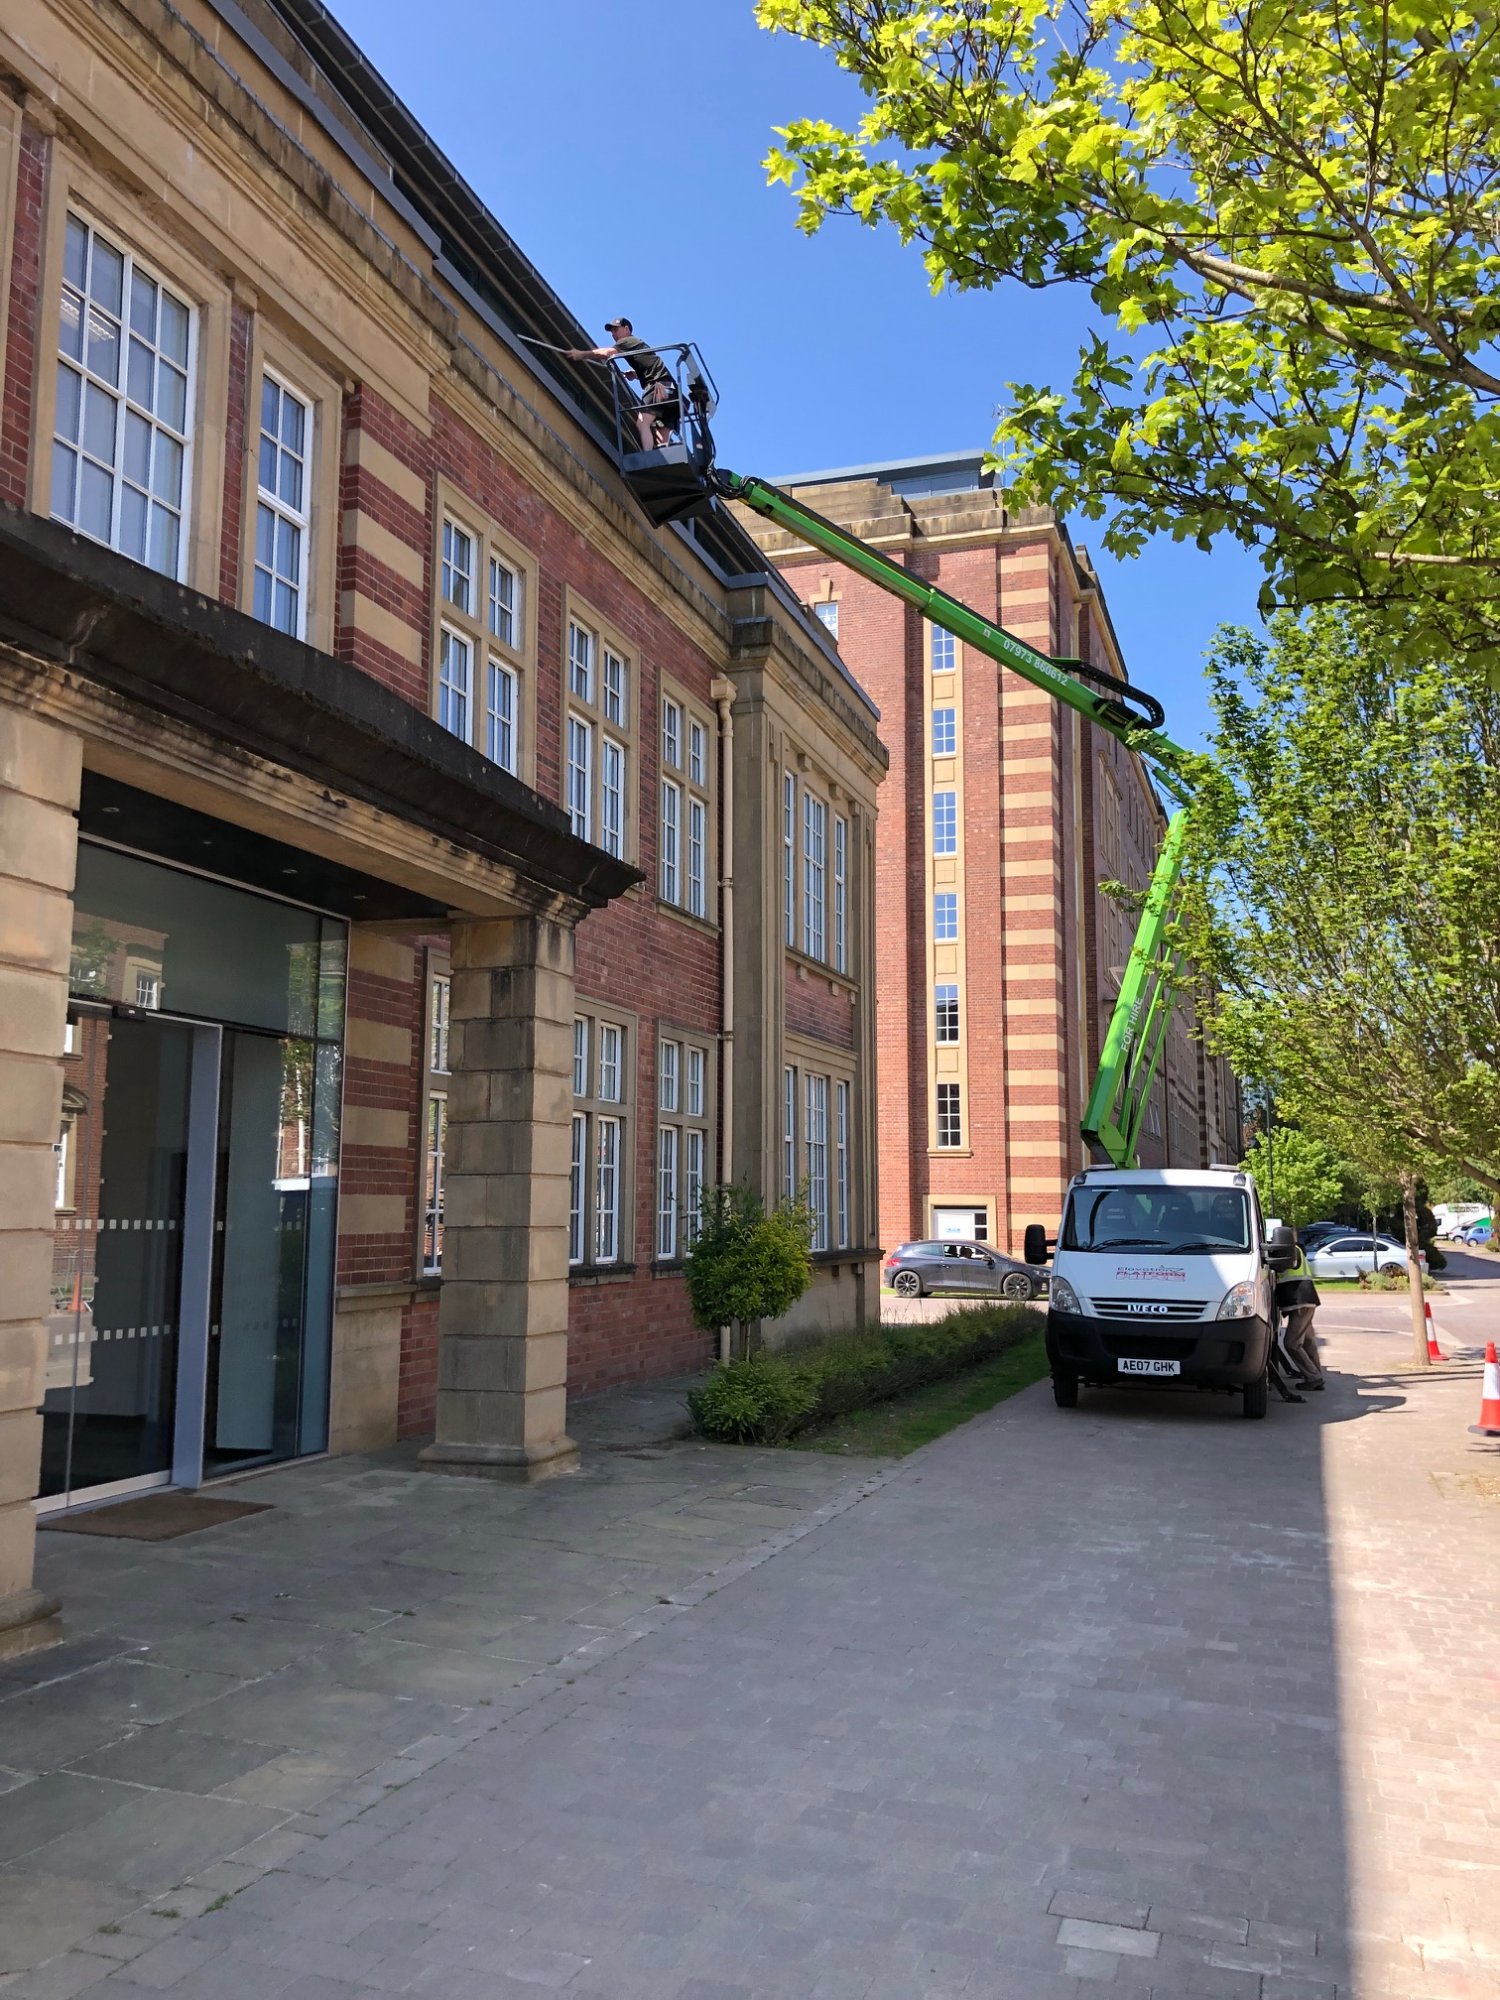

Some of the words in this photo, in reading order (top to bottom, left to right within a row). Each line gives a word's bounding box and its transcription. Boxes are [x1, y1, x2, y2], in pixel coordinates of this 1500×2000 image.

[1003, 640, 1032, 664] 07973
[1120, 1027, 1134, 1052] FOR
[1128, 998, 1143, 1025] HIRE
[1127, 1304, 1168, 1314] IVECO
[1123, 1360, 1150, 1371] AE07
[1153, 1362, 1175, 1372] GHK
